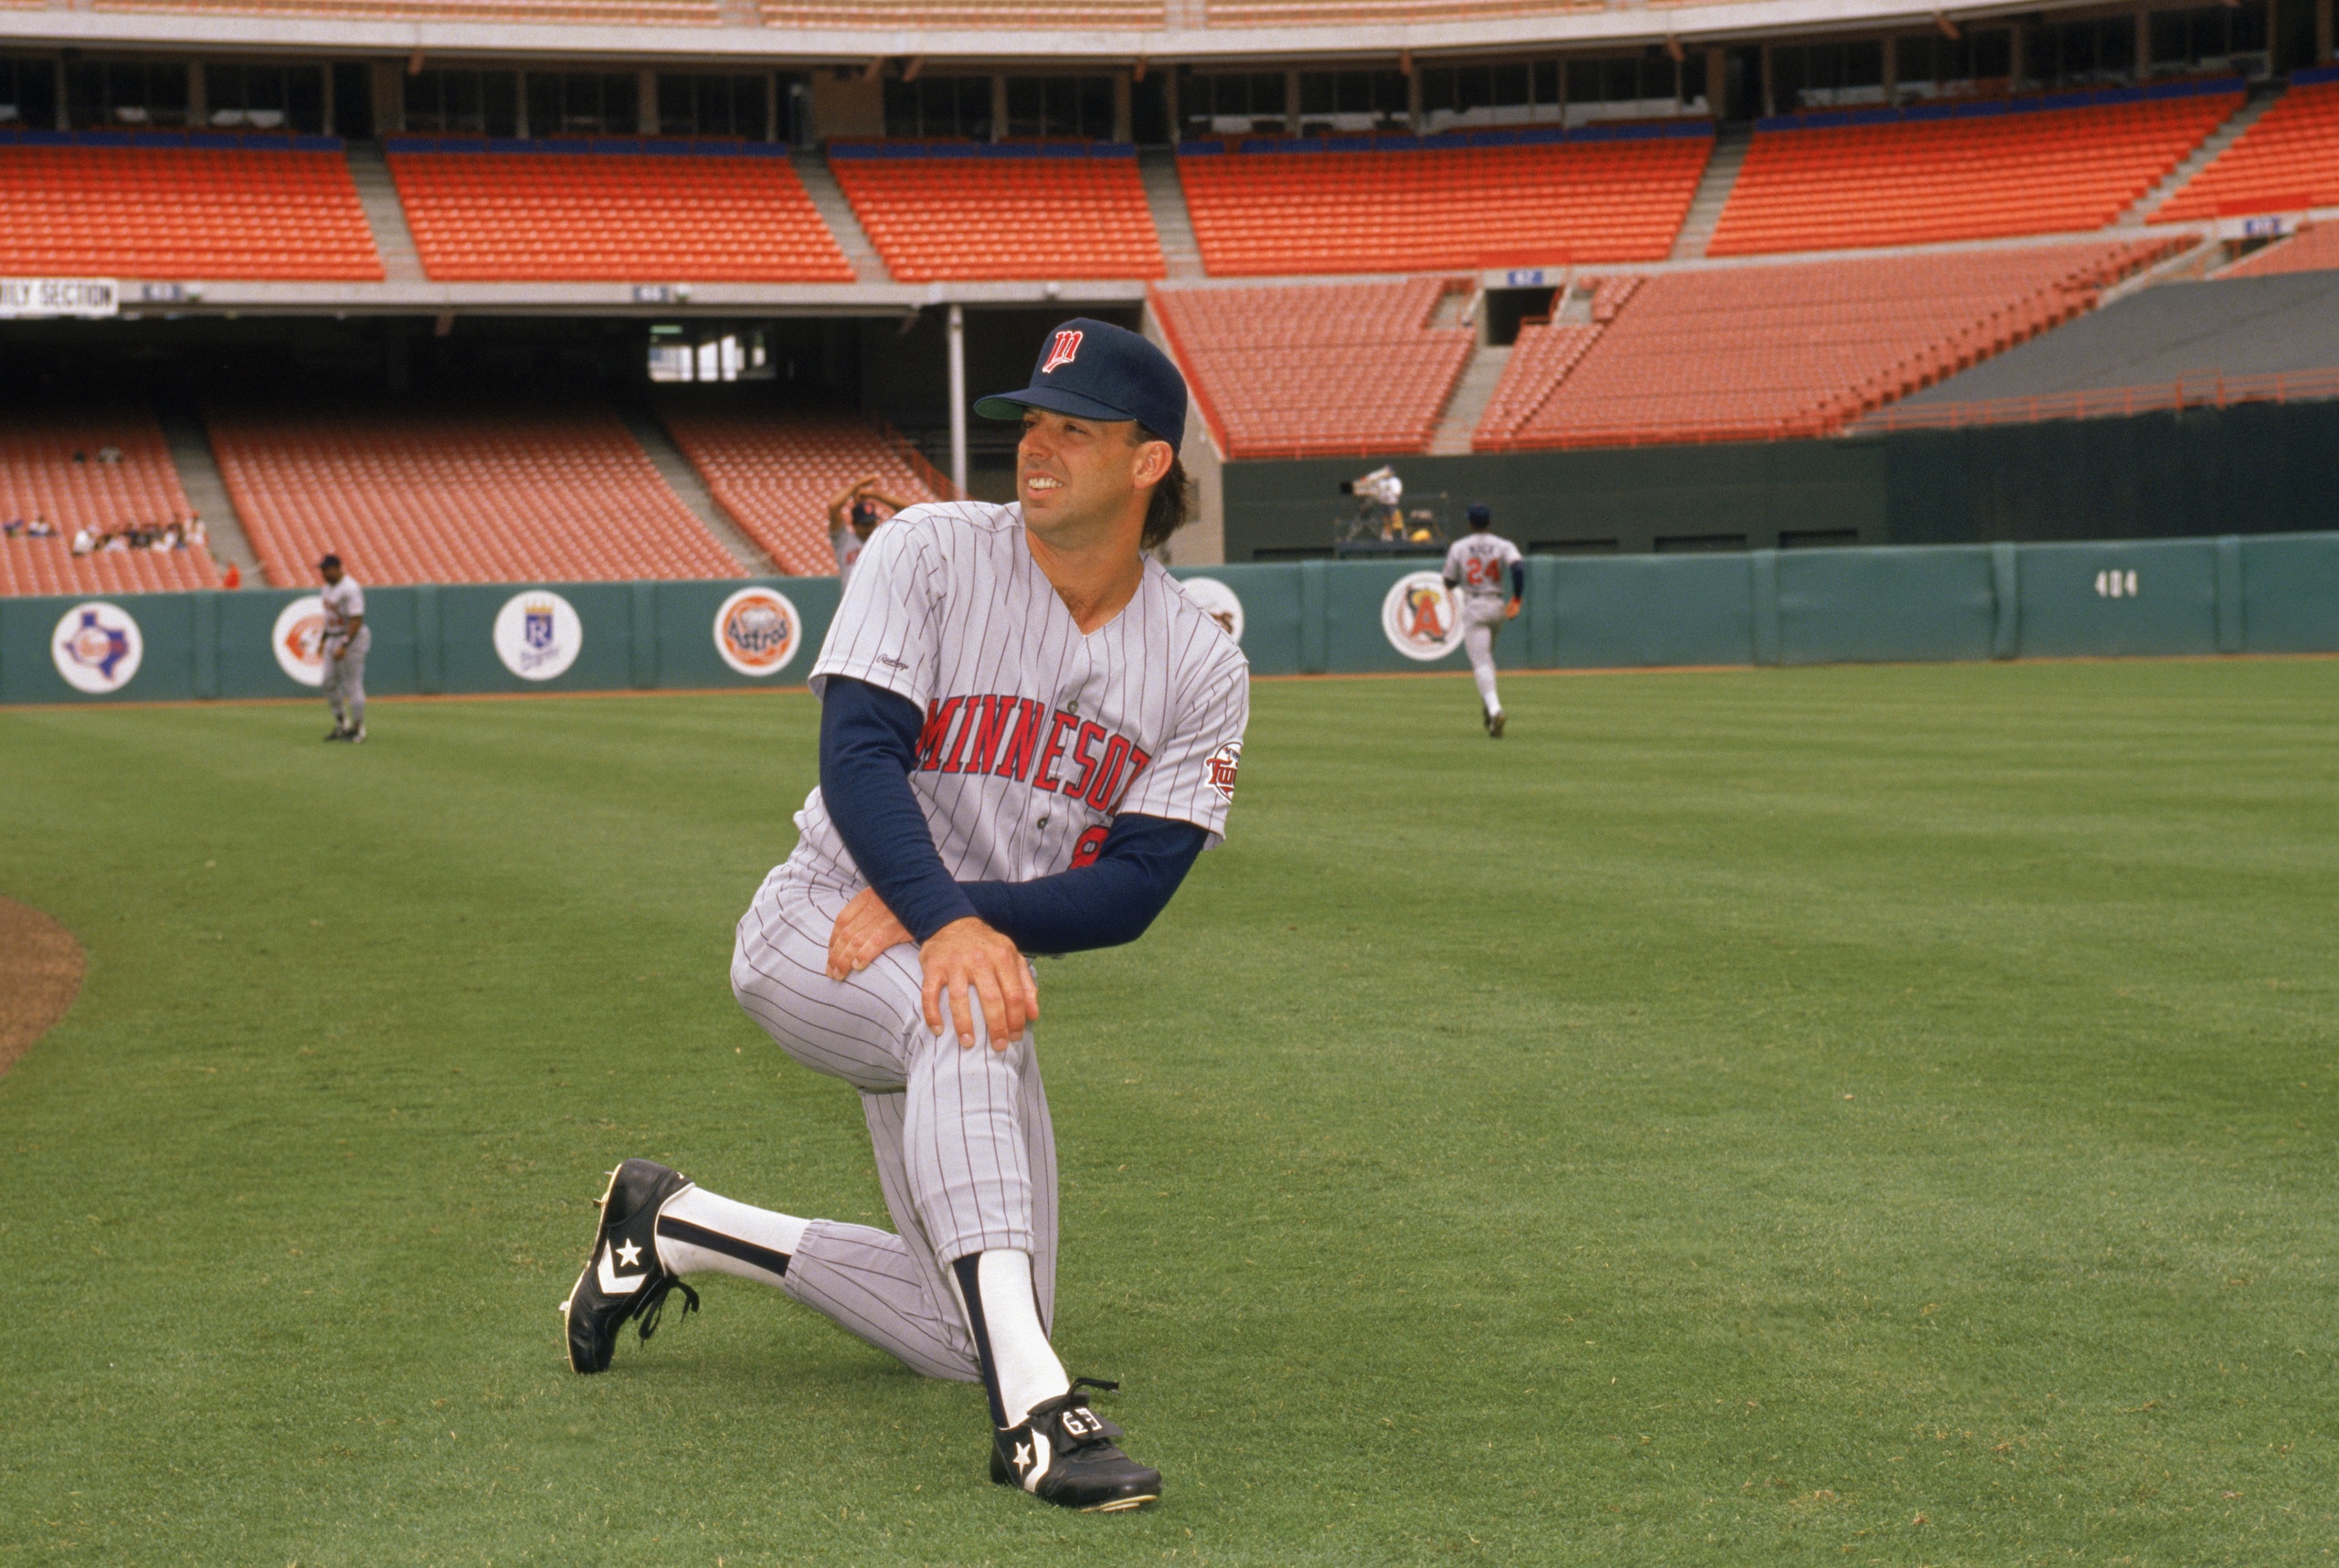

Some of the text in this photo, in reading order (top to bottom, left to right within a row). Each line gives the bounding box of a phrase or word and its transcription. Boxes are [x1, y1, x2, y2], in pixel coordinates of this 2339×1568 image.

[0, 284, 111, 307] ILY SECTION
[1466, 556, 1501, 585] 24
[2094, 569, 2138, 599] 404
[727, 618, 788, 652] Astros
